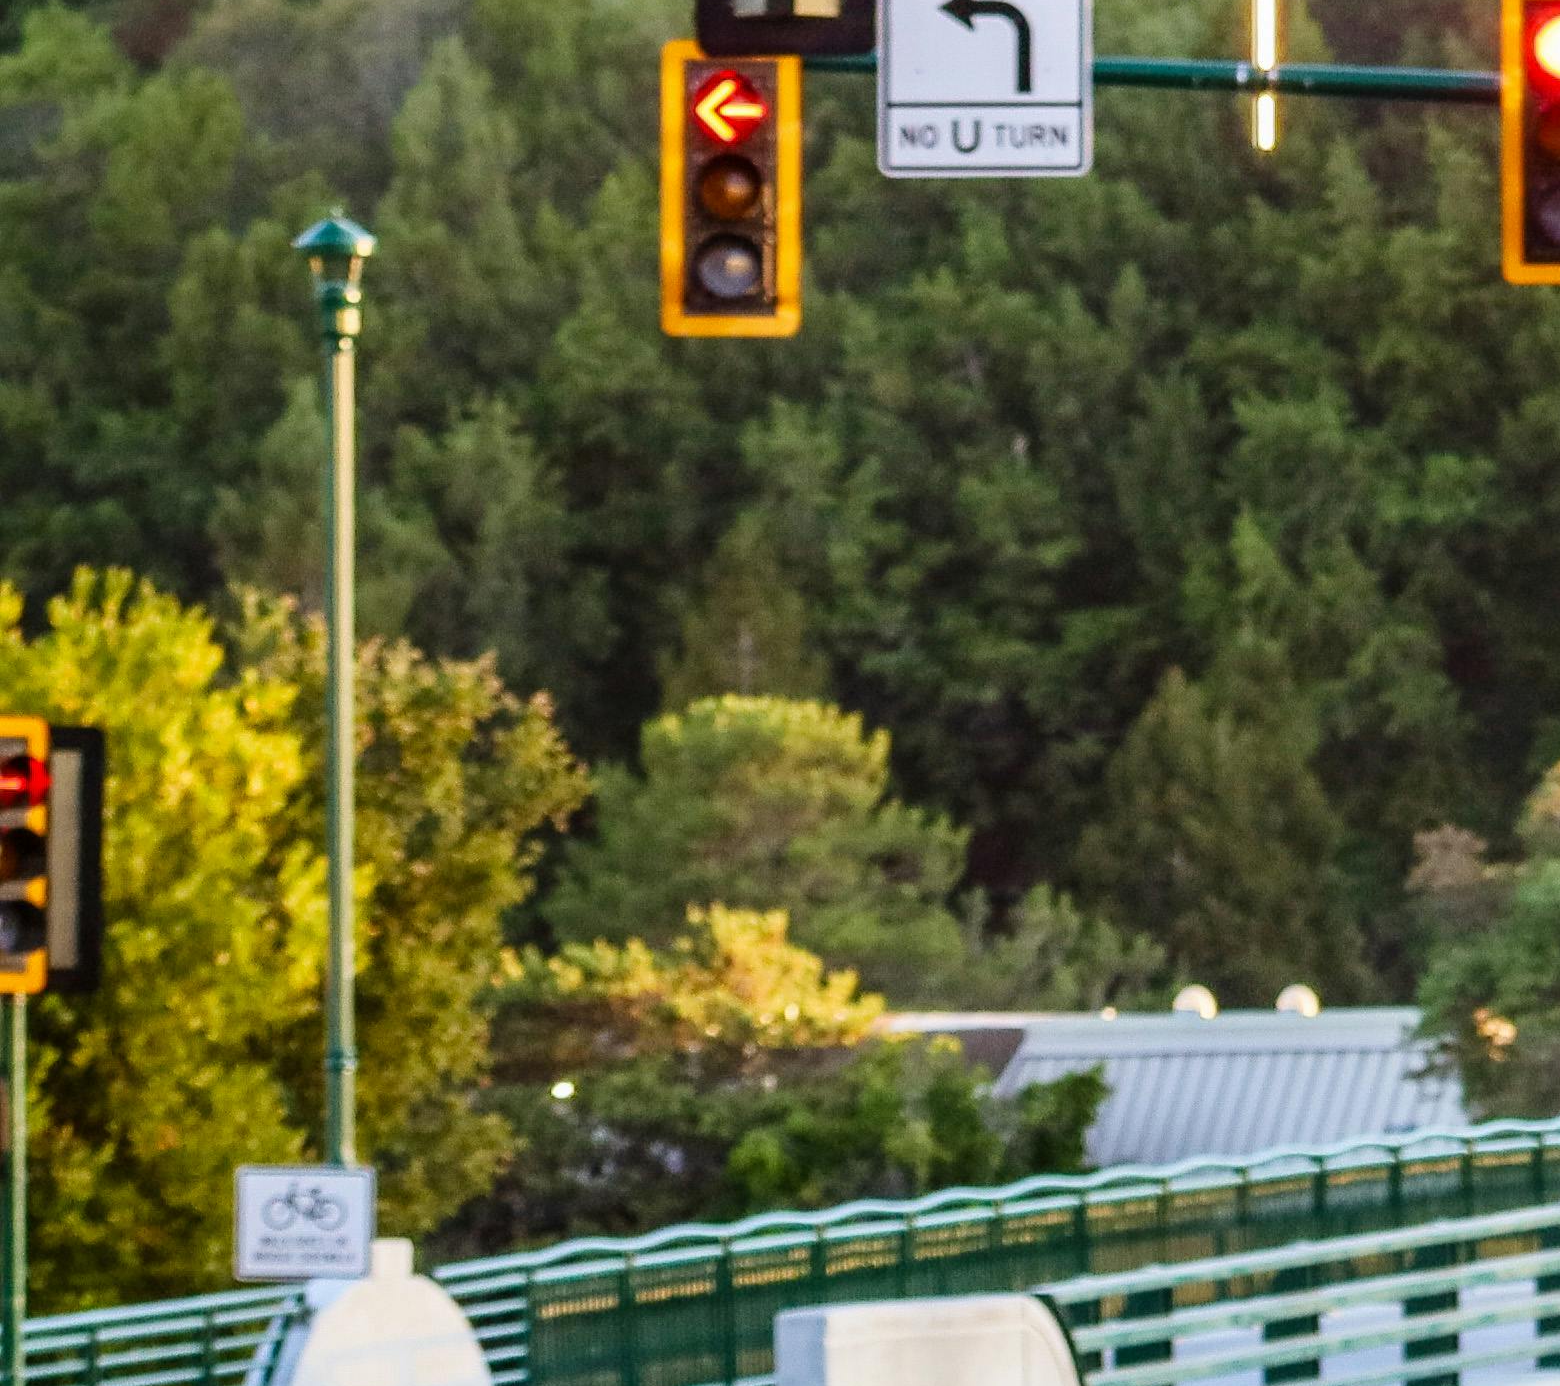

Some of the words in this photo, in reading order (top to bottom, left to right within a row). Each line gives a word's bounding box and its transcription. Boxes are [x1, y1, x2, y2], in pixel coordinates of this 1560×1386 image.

[899, 124, 940, 150] NO
[952, 119, 982, 154] U
[993, 123, 1070, 149] TURN
